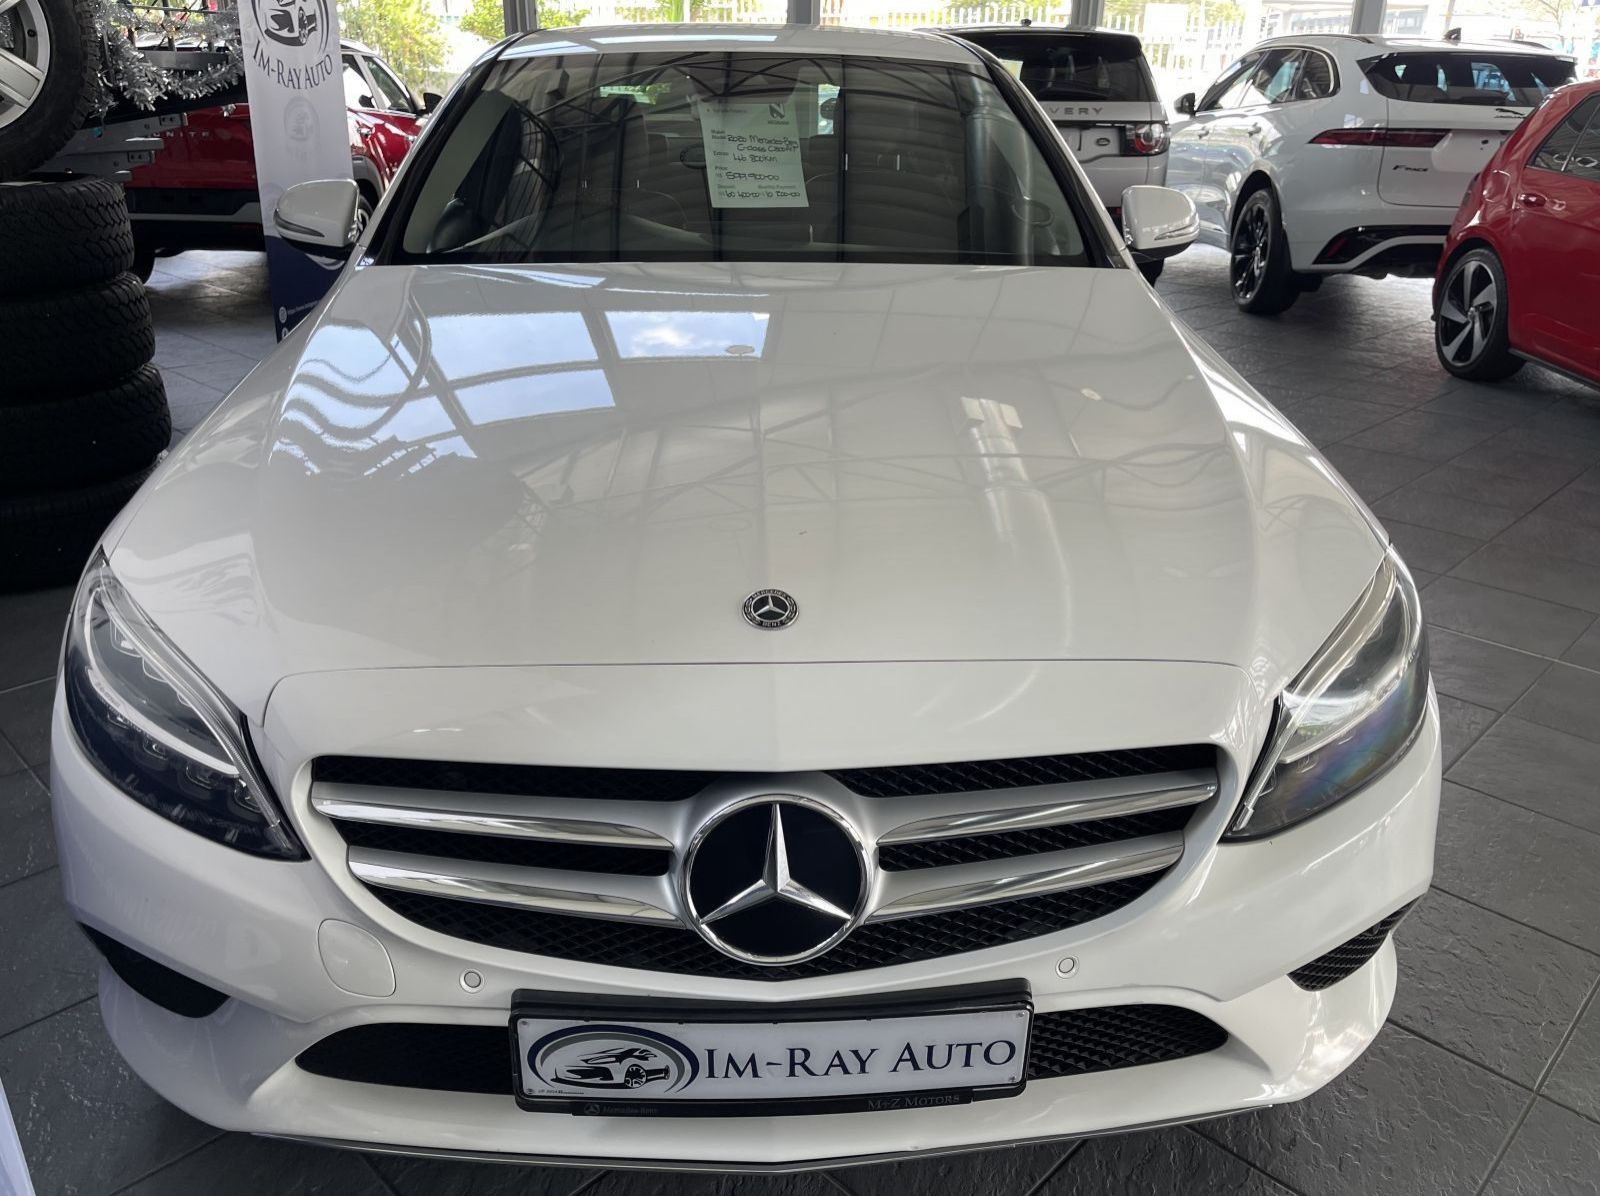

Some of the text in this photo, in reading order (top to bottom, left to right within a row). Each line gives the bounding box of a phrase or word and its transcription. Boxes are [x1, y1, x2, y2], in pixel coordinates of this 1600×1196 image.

[253, 39, 333, 90] IM-RAY AUTO
[705, 1040, 1017, 1079] IM-RAY AUTO
[904, 1095, 960, 1107] MOTORS
